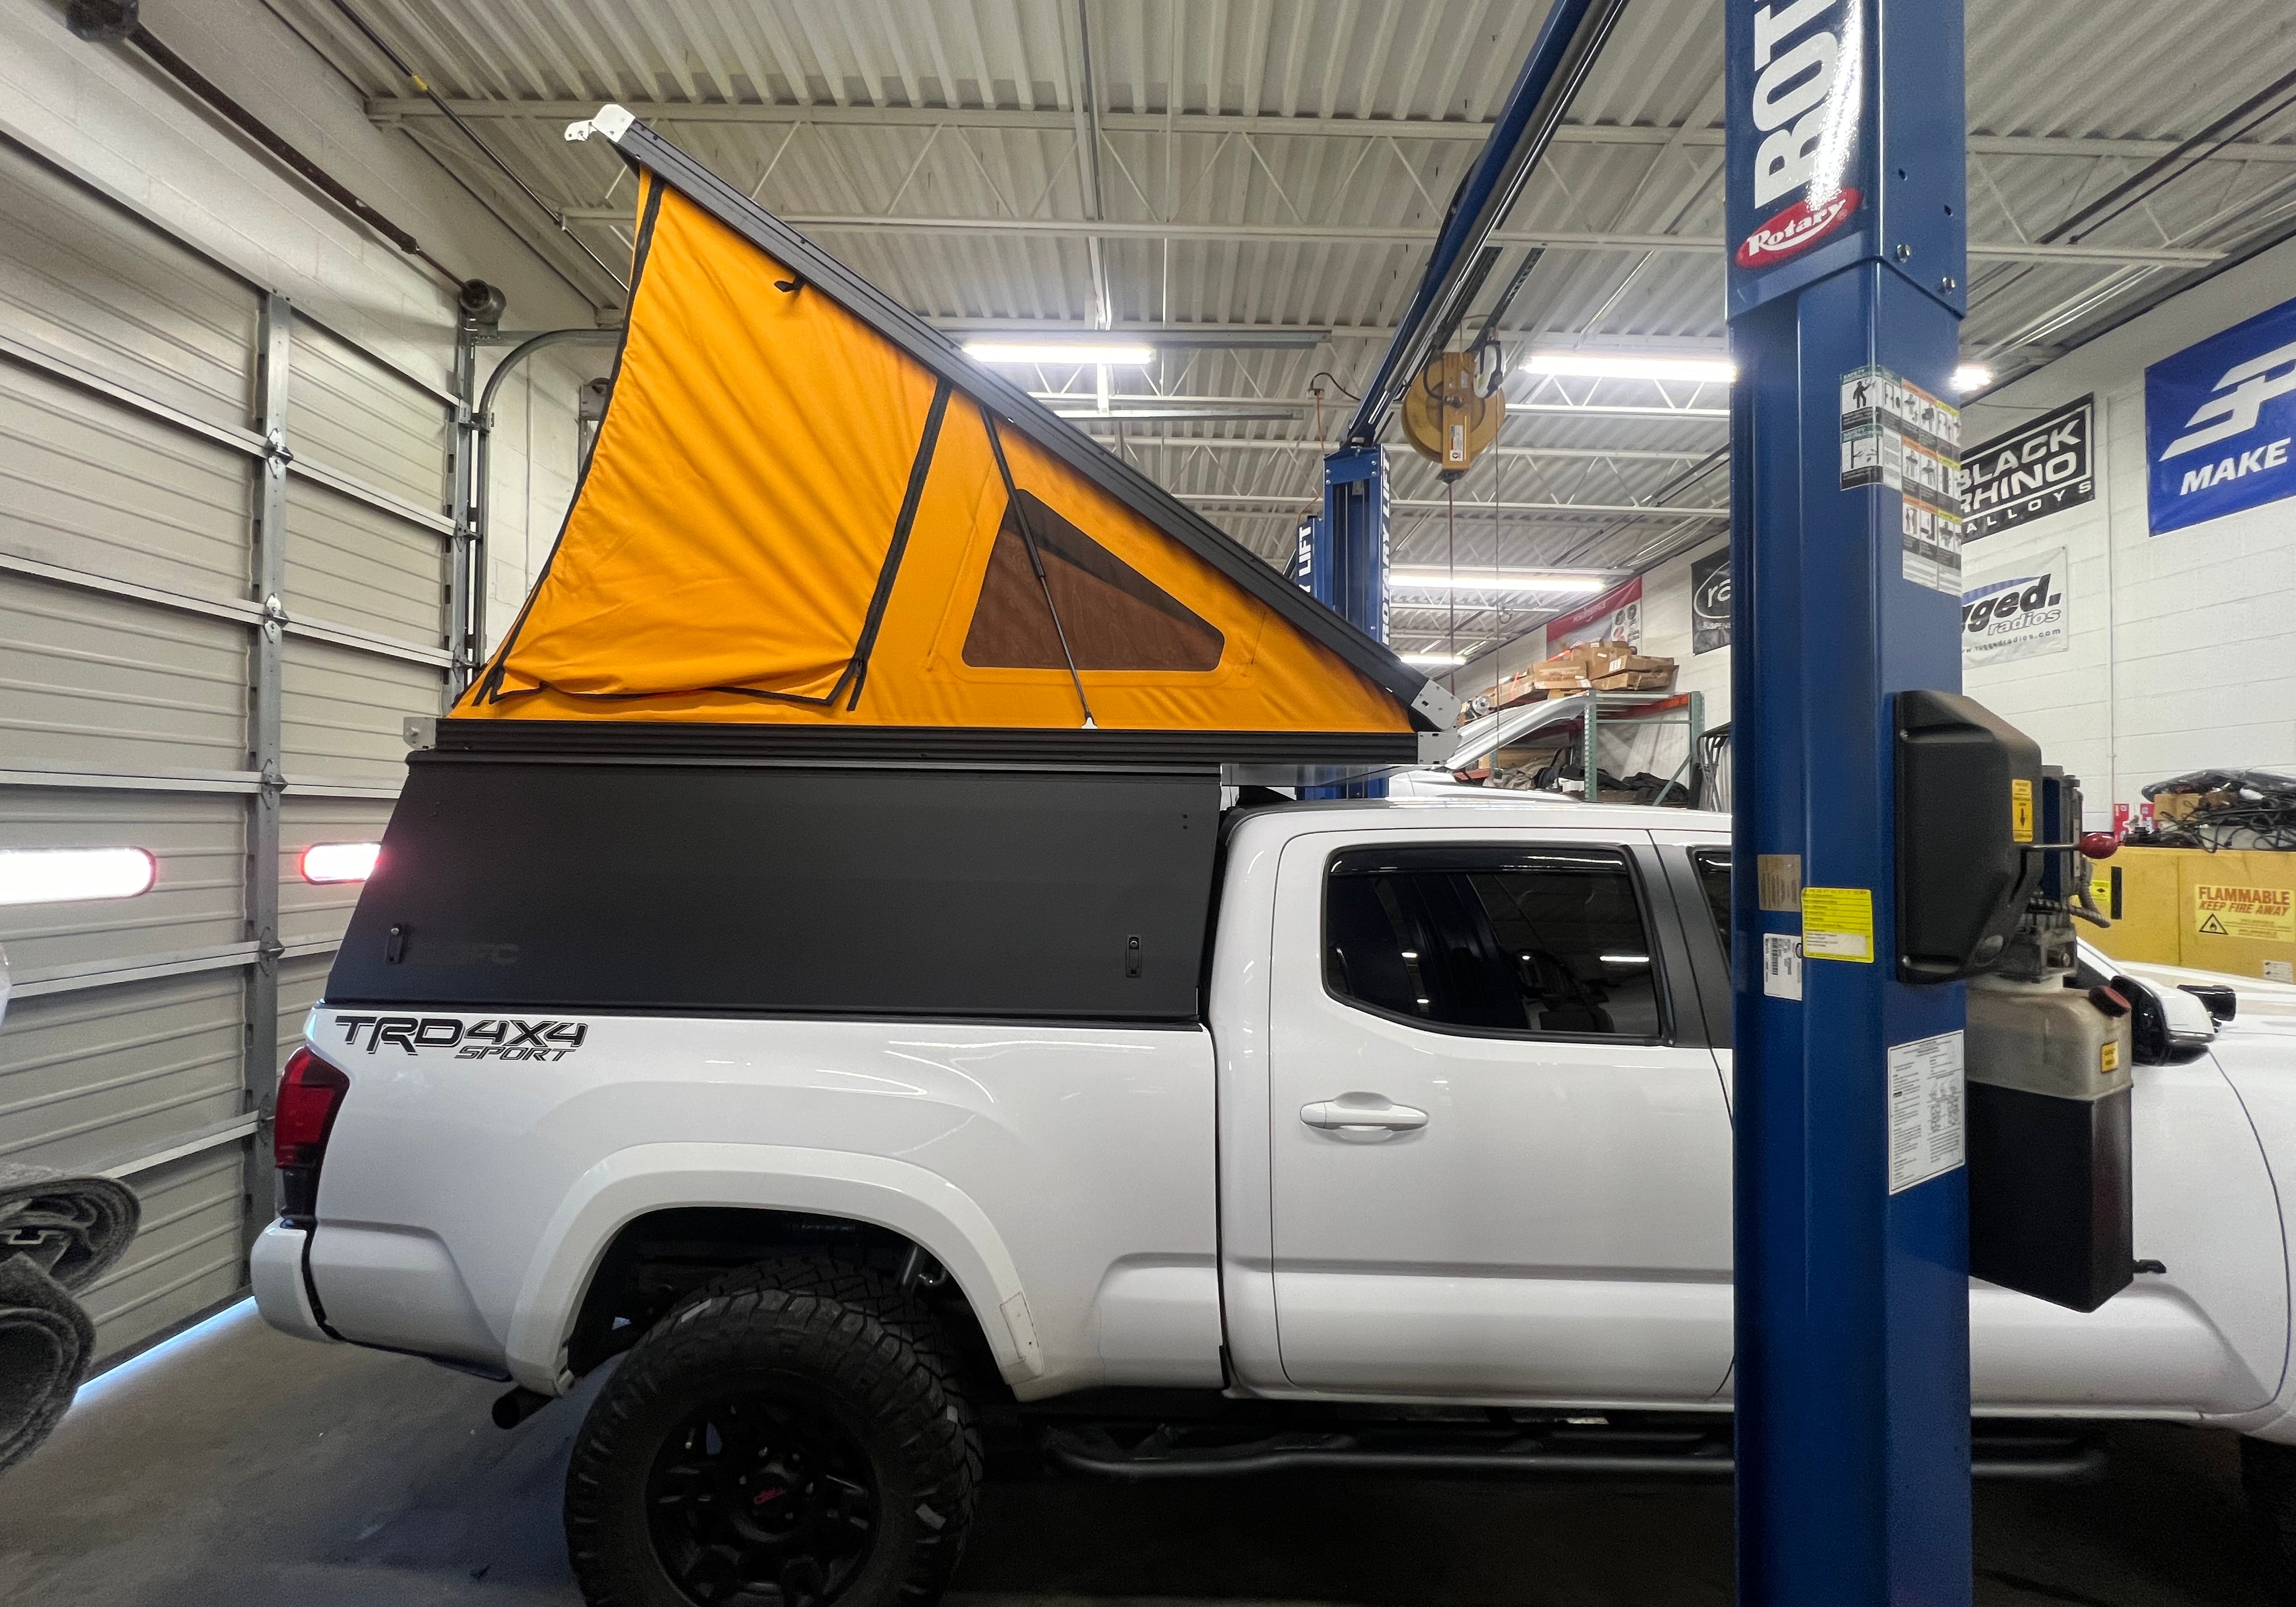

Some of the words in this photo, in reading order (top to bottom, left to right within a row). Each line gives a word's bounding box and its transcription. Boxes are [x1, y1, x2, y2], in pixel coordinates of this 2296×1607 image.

[1747, 198, 1846, 256] Rotary
[1382, 452, 1391, 519] LIFT
[2180, 437, 2291, 496] MAKE
[1966, 481, 2092, 534] ALLOYS
[1298, 526, 1312, 577] LIFT
[1381, 523, 1391, 646] ROTARY
[1987, 609, 2062, 637] radios
[2199, 886, 2290, 905] FLAMMABLE
[2199, 900, 2227, 911] KEEP
[2228, 903, 2254, 914] FIRE
[2255, 904, 2290, 917] AWAY
[335, 1015, 464, 1056] TRD
[464, 1019, 589, 1048] 4X4
[454, 1046, 576, 1062] SPORT
